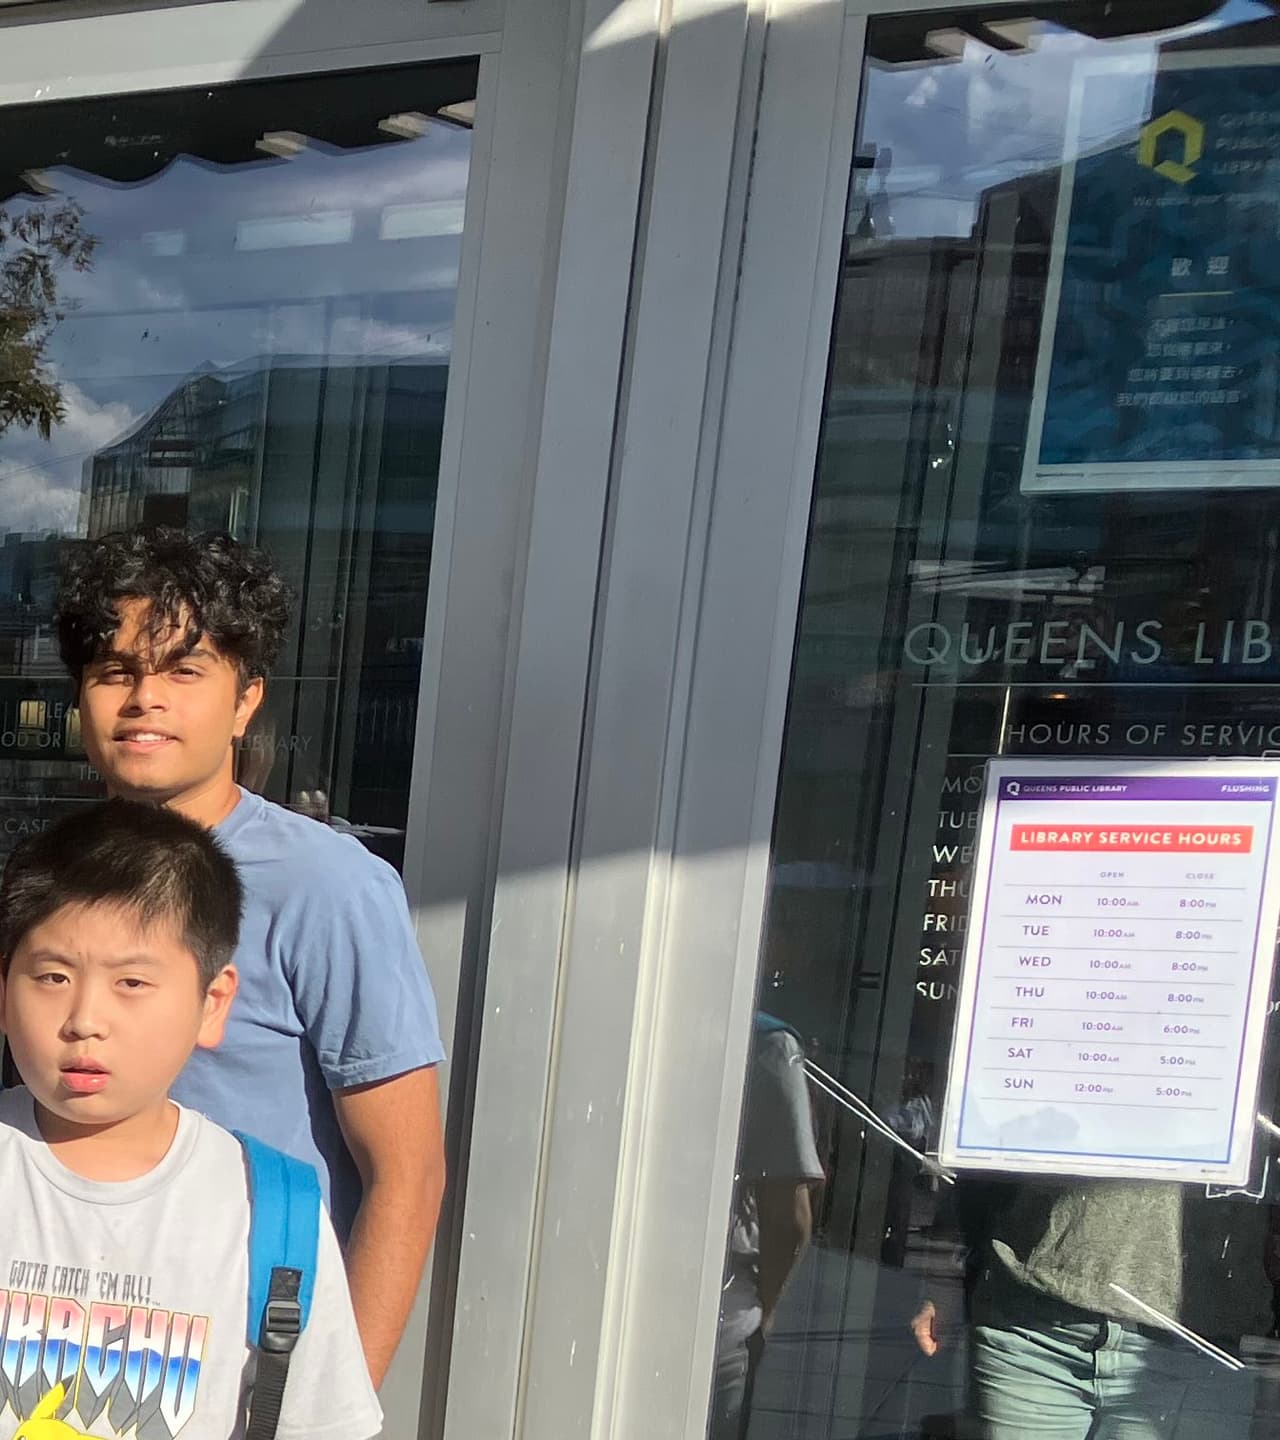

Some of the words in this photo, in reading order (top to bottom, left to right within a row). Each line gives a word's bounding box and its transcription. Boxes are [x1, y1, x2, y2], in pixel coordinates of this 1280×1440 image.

[903, 619, 1163, 665] QUEENS
[38, 731, 61, 748] OR
[1008, 724, 1111, 746] HOURS
[1126, 724, 1167, 745] OF
[1023, 784, 1058, 793] QUEENS
[1059, 784, 1090, 793] PUBLIC
[1091, 784, 1128, 793] LIBRARY
[1220, 784, 1270, 793] FLUSHING
[1020, 831, 1095, 844] LIBRARY
[1098, 831, 1172, 845] SERVICE
[1178, 832, 1242, 846] HOURS
[1099, 871, 1125, 879] OPEN
[1185, 872, 1215, 880] CLOSE
[1025, 894, 1063, 905] MON
[1022, 925, 1050, 936] TUE
[1018, 956, 1052, 967] WED
[1015, 986, 1045, 998] THU
[1011, 1017, 1034, 1028] FRI
[1007, 1048, 1034, 1059] SAT
[1004, 1078, 1035, 1090] SUN
[8, 1260, 49, 1292] GOTTA
[51, 1265, 91, 1297] CATCH
[95, 1271, 119, 1300] 'EM
[122, 1274, 152, 1306] ALL!
